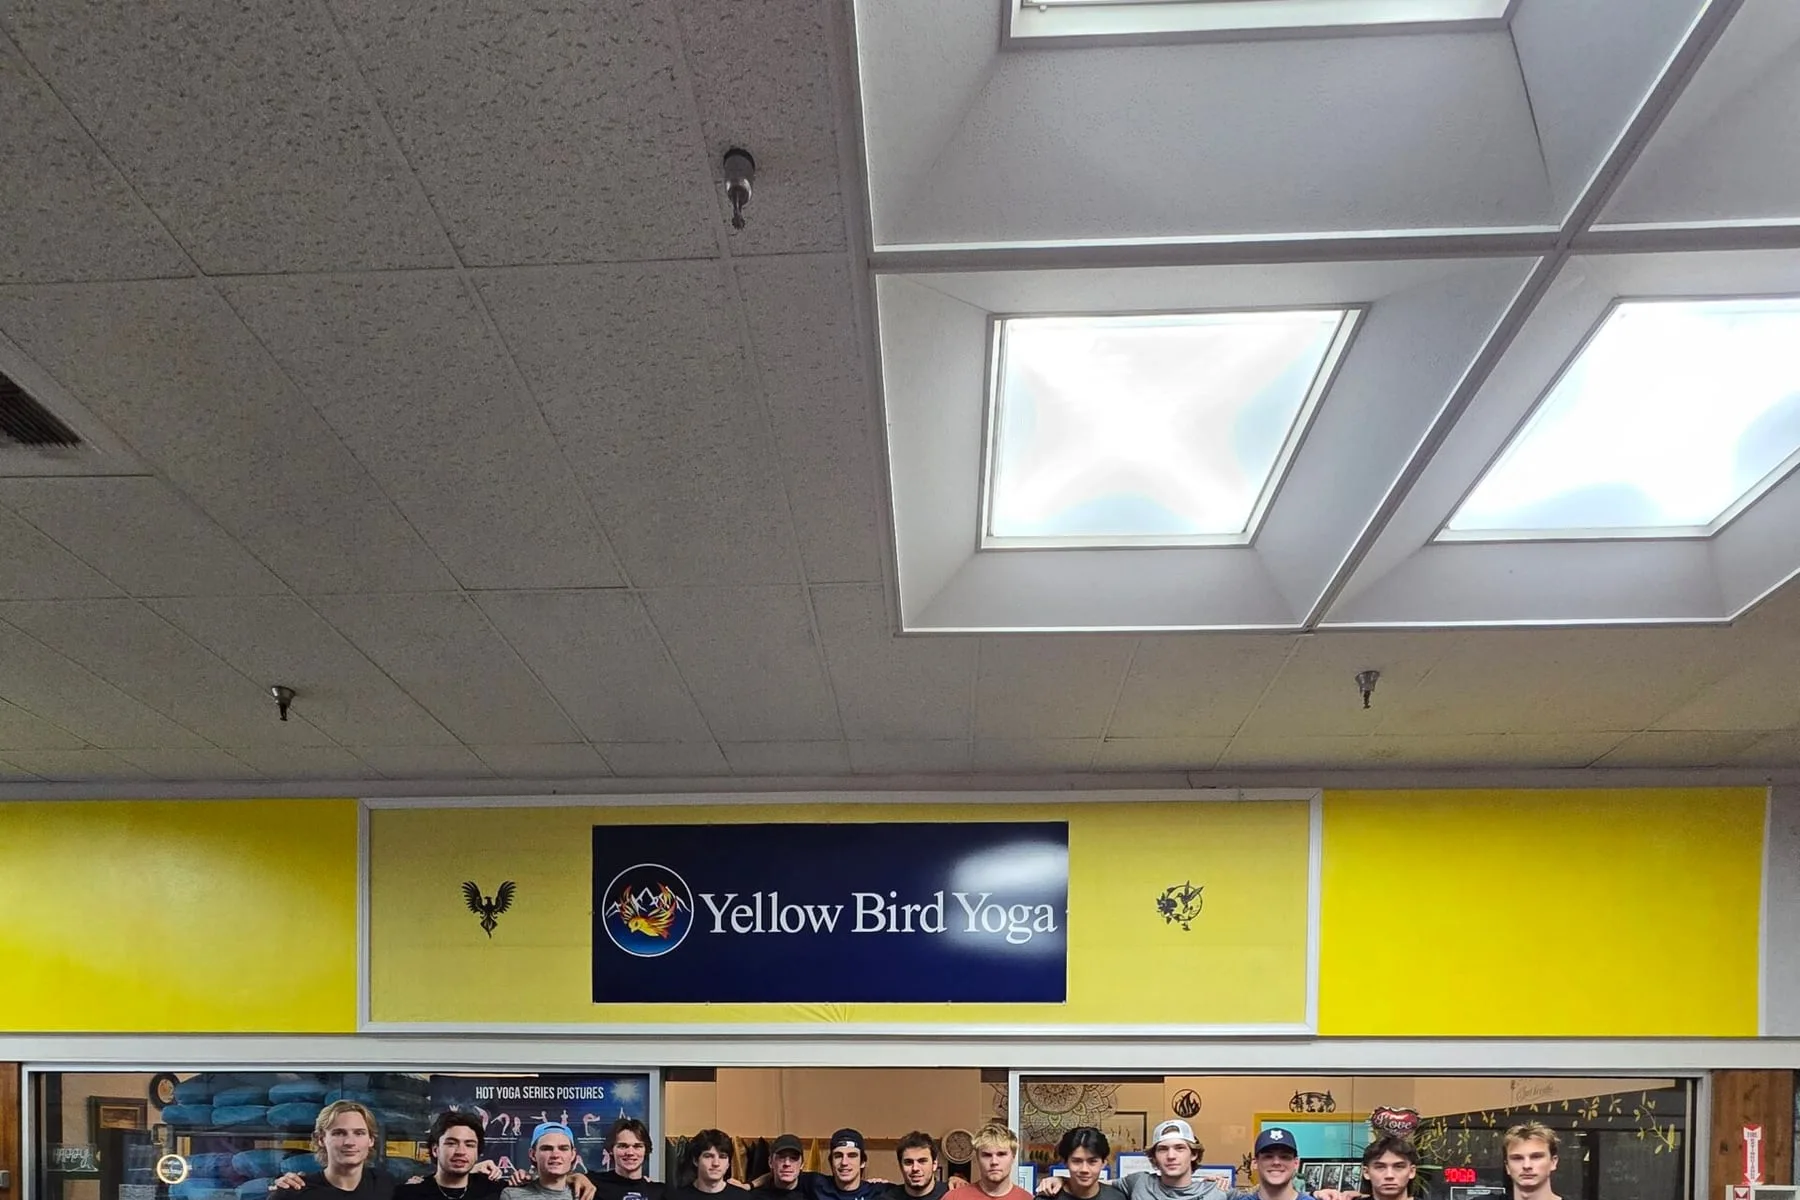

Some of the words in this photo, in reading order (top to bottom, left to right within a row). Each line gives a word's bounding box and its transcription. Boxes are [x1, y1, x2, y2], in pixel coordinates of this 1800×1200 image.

[698, 891, 844, 934] Yellow
[851, 890, 948, 934] Bird
[952, 891, 1058, 944] Yoga
[475, 1086, 494, 1099] HOT
[496, 1086, 521, 1099] YOGA
[522, 1086, 555, 1099] SERIES
[556, 1086, 604, 1099] POSTURES
